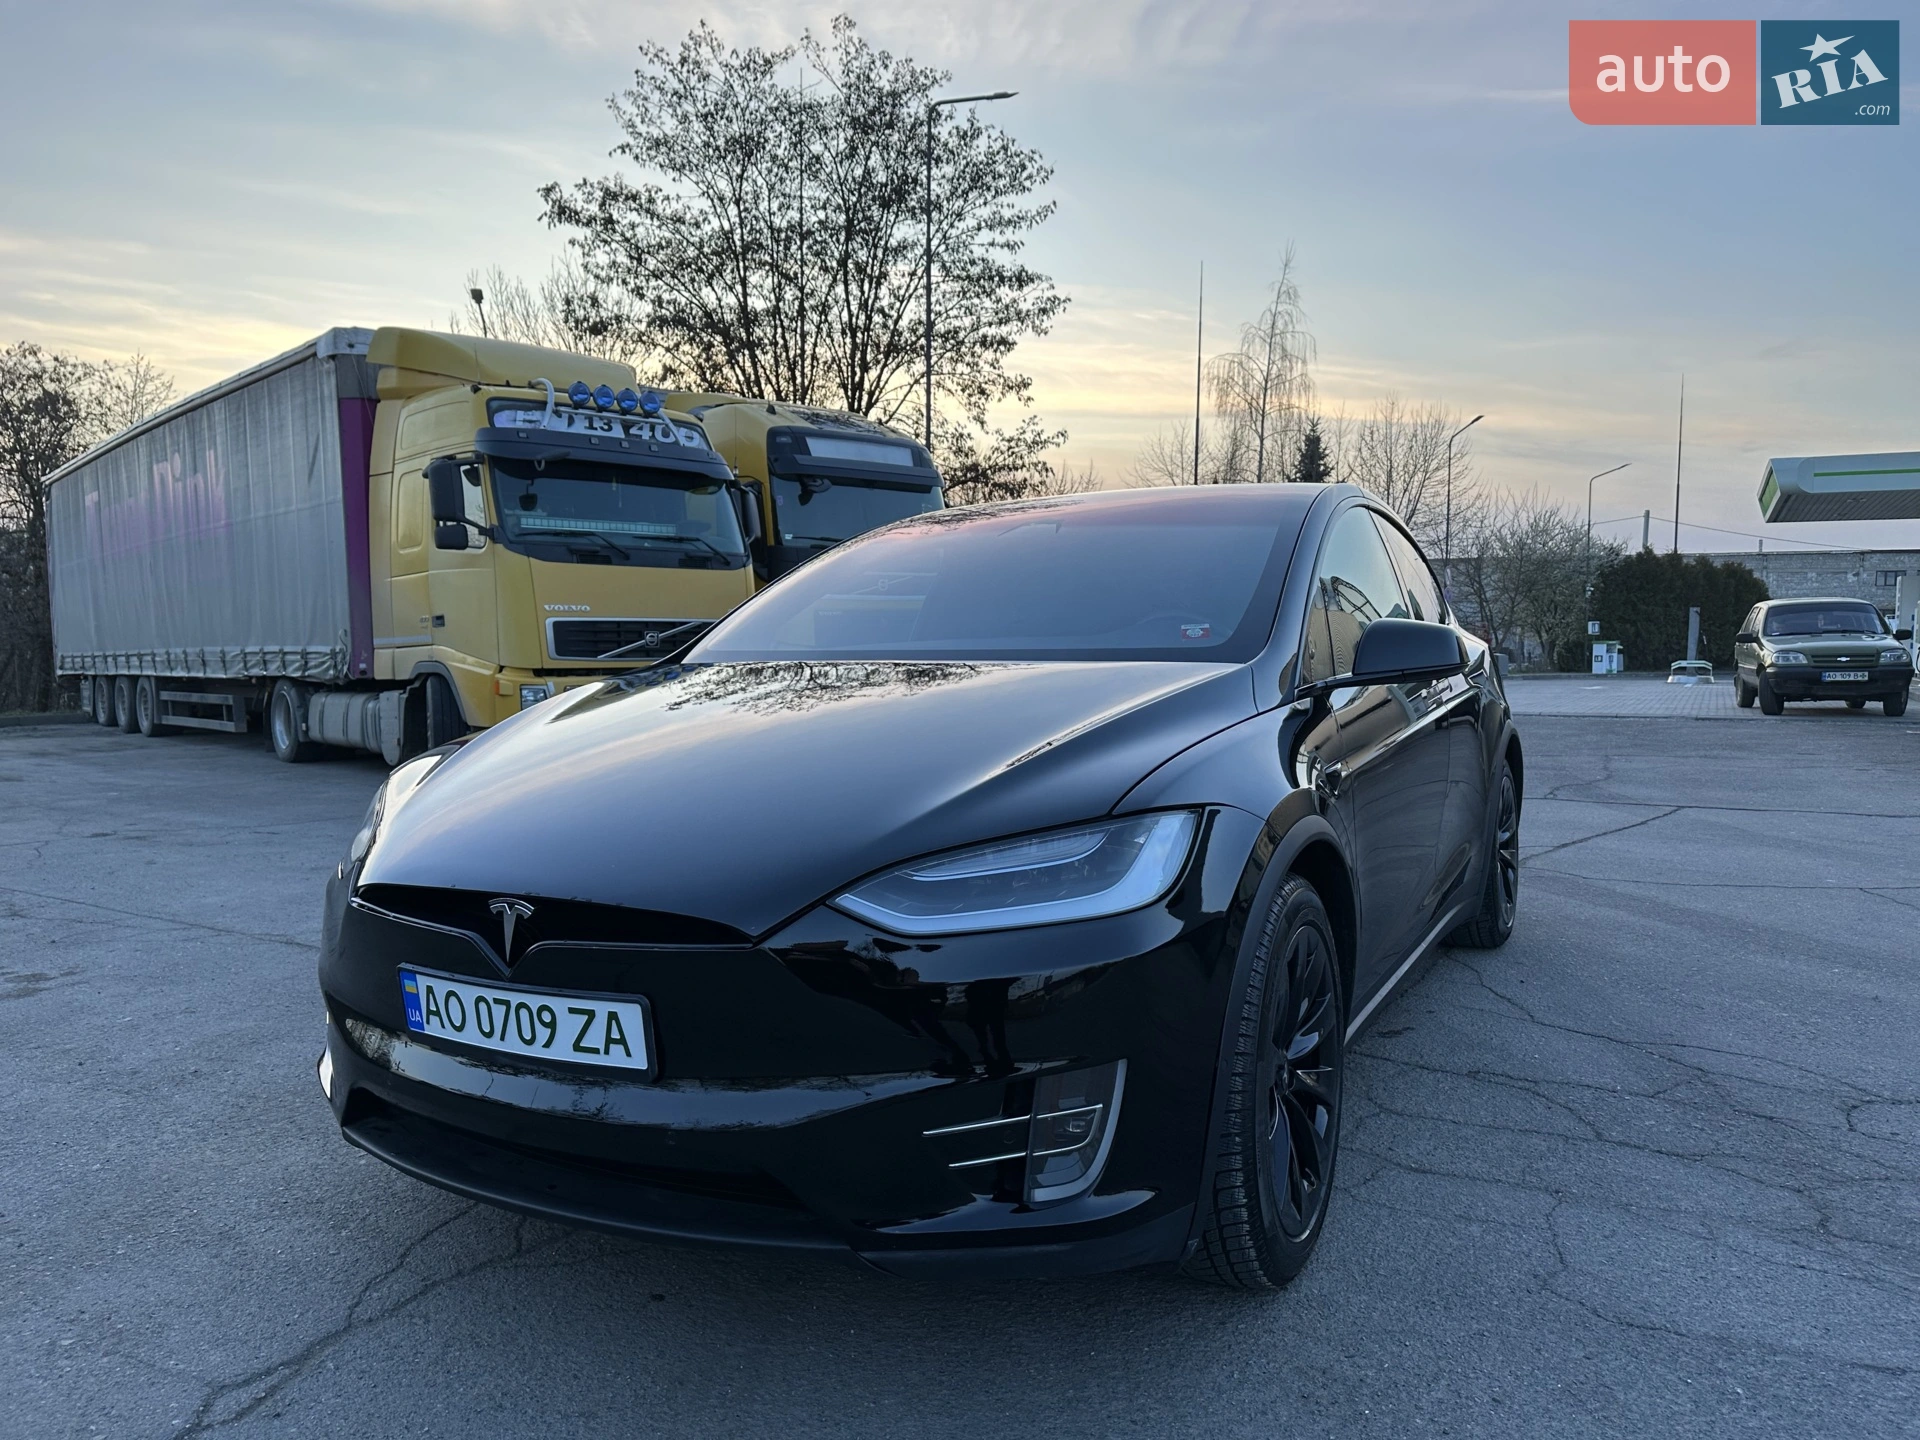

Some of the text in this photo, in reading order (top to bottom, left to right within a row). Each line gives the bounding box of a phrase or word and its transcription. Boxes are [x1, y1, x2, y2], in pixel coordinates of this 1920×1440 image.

[543, 604, 591, 612] VOLVO
[408, 1008, 422, 1024] UA
[425, 984, 633, 1058] AO 0709 ZA
